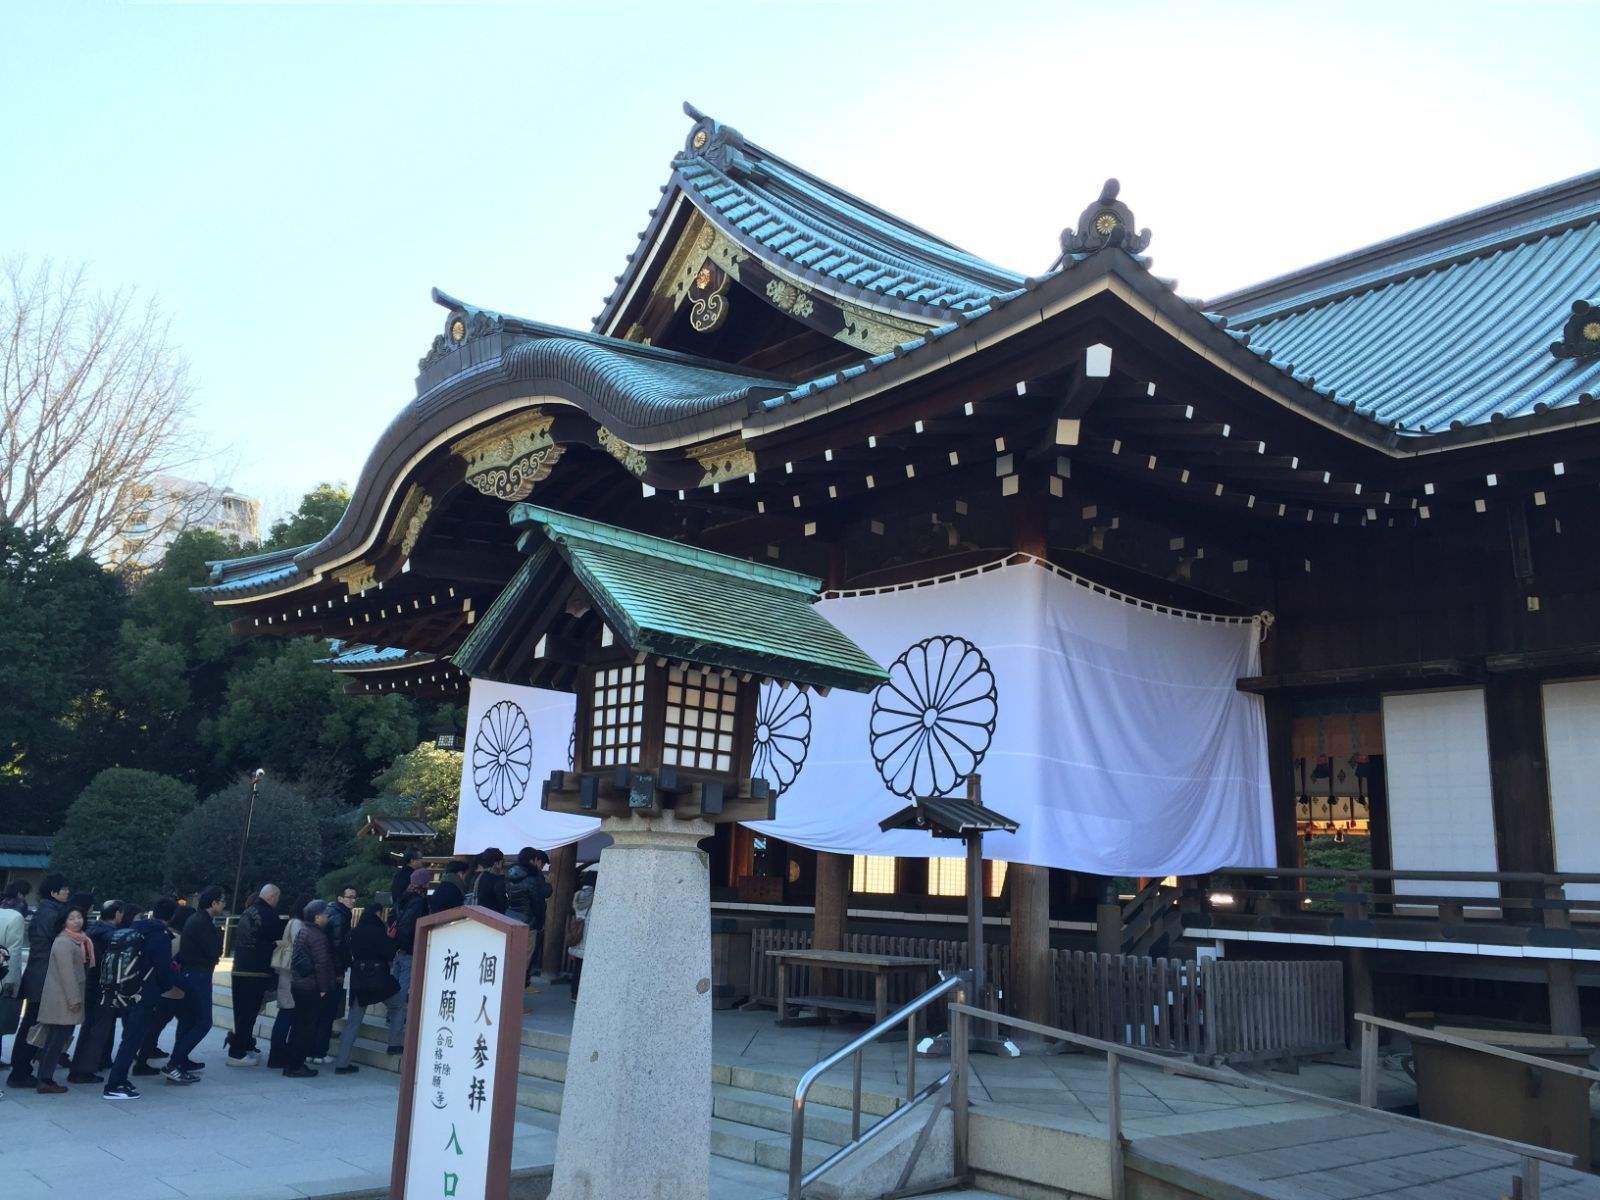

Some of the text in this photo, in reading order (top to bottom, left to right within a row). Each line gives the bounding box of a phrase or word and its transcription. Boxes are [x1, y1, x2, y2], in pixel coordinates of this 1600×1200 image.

[438, 949, 460, 1023] 祈願
[467, 952, 497, 1113] 個人参拝
[444, 1123, 463, 1197] 入口
